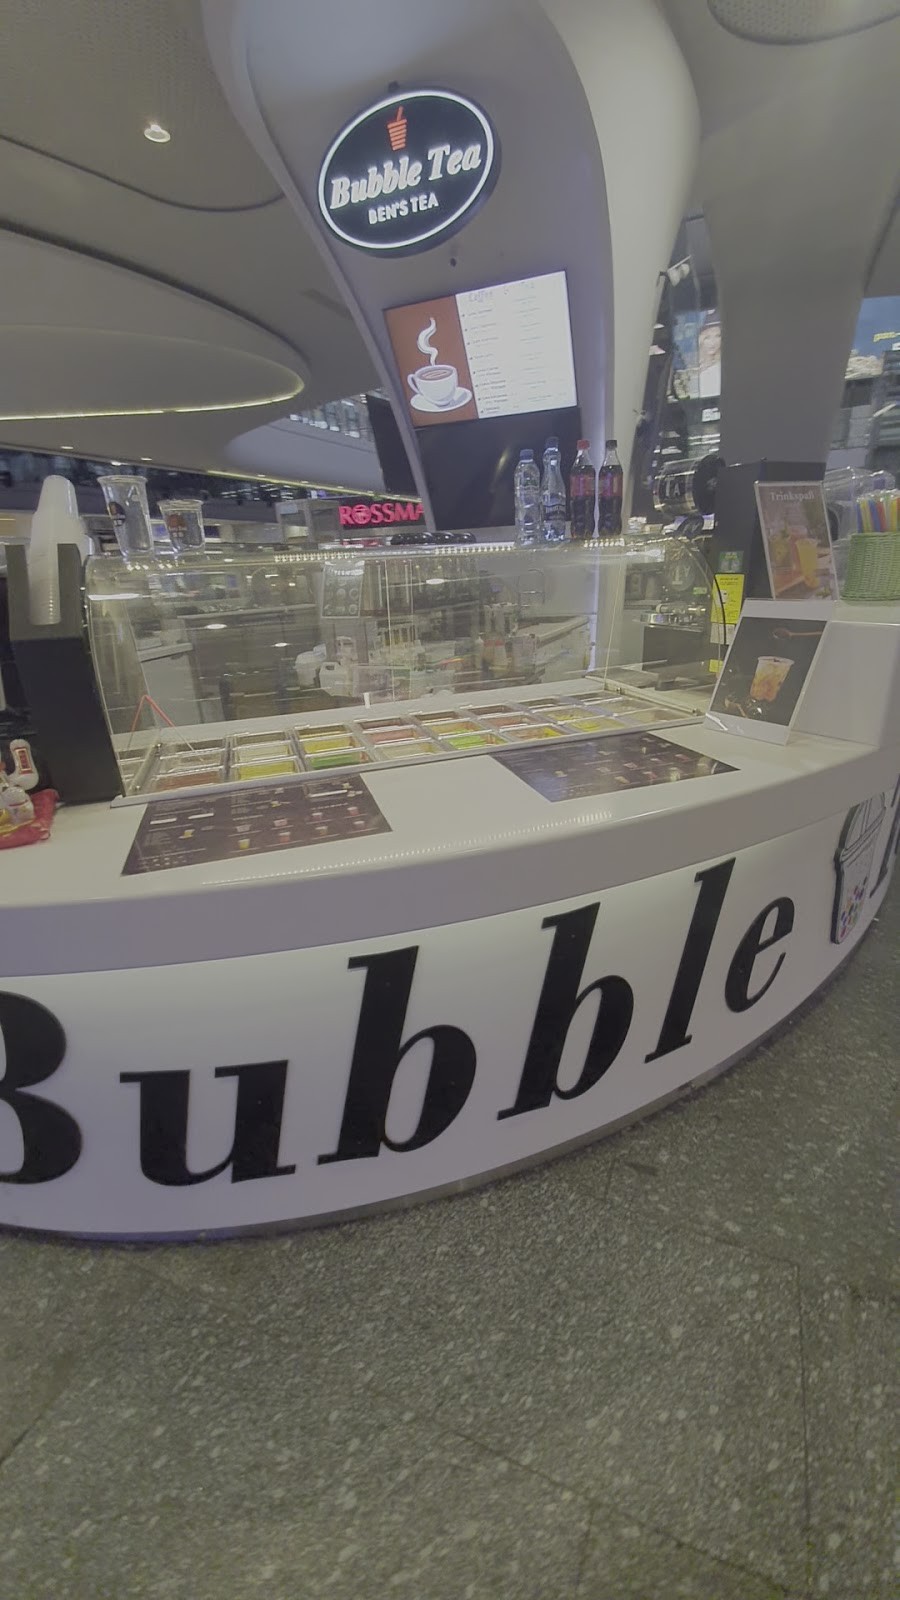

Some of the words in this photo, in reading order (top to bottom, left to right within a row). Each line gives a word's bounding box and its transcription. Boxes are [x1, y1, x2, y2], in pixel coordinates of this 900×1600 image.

[330, 155, 423, 209] Bubble
[427, 144, 482, 181] Tea
[368, 199, 409, 225] BEN'S
[409, 192, 439, 213] TEA
